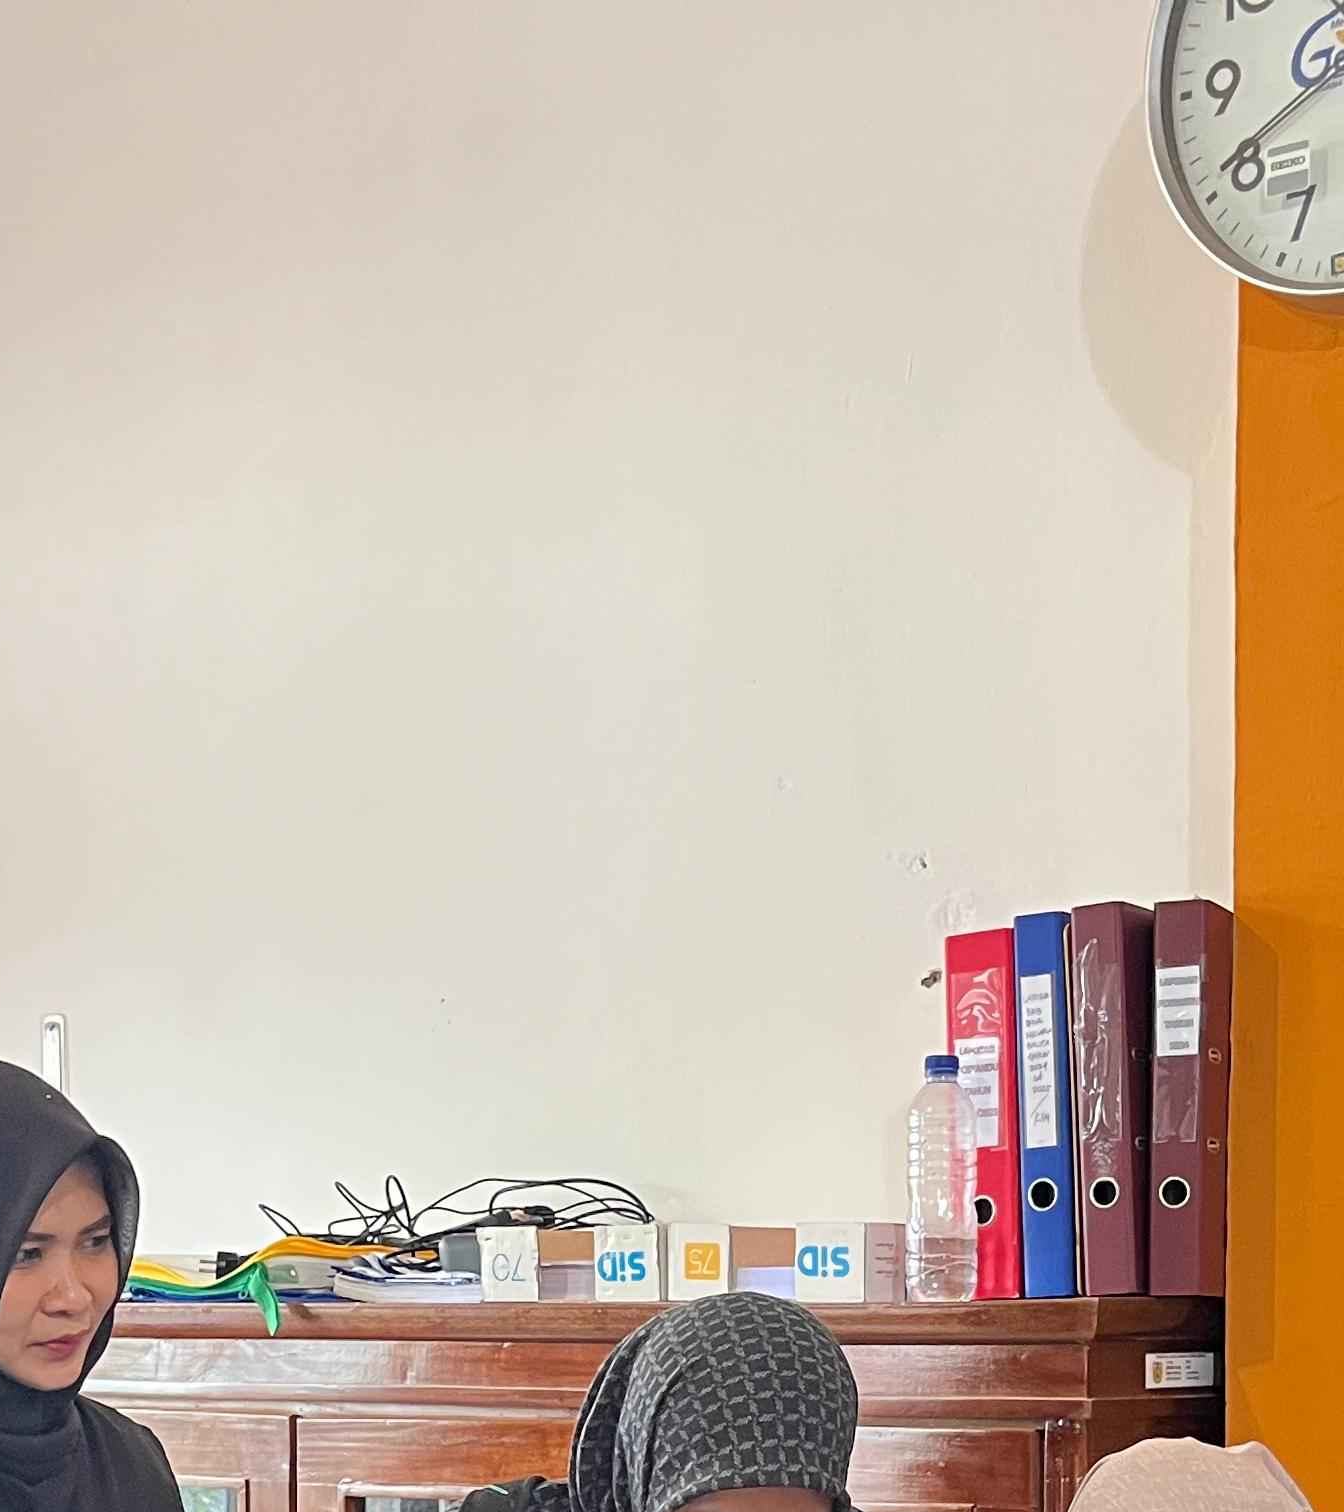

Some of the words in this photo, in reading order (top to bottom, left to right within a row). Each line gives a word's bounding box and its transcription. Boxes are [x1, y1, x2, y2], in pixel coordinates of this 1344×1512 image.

[1205, 59, 1241, 117] 9
[1231, 138, 1265, 192] 8
[1286, 184, 1317, 242] 7
